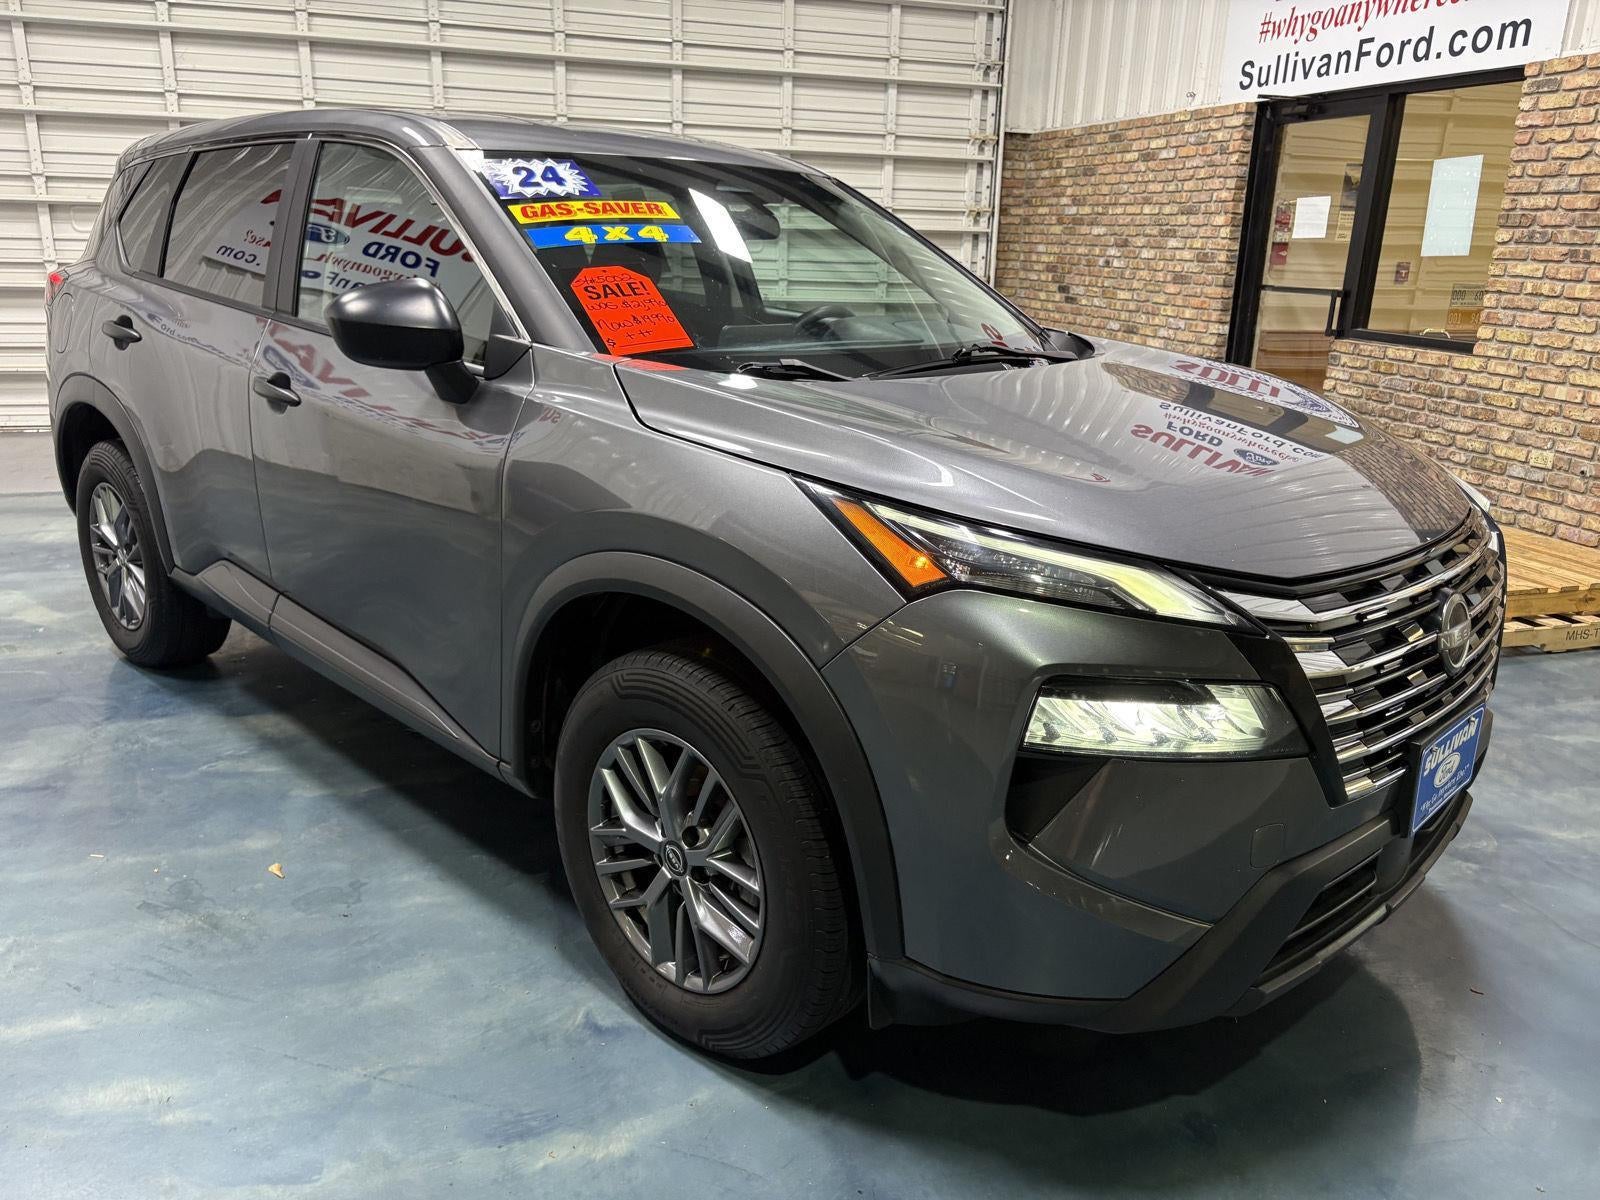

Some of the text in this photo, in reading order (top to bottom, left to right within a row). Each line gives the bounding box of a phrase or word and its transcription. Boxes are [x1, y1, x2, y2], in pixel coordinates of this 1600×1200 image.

[1239, 17, 1532, 91] SullivanFord.com
[512, 165, 566, 188] 24
[520, 202, 664, 220] GAS-SAVER
[583, 280, 651, 300] SALE!
[1423, 716, 1479, 777] SULLIVAN
